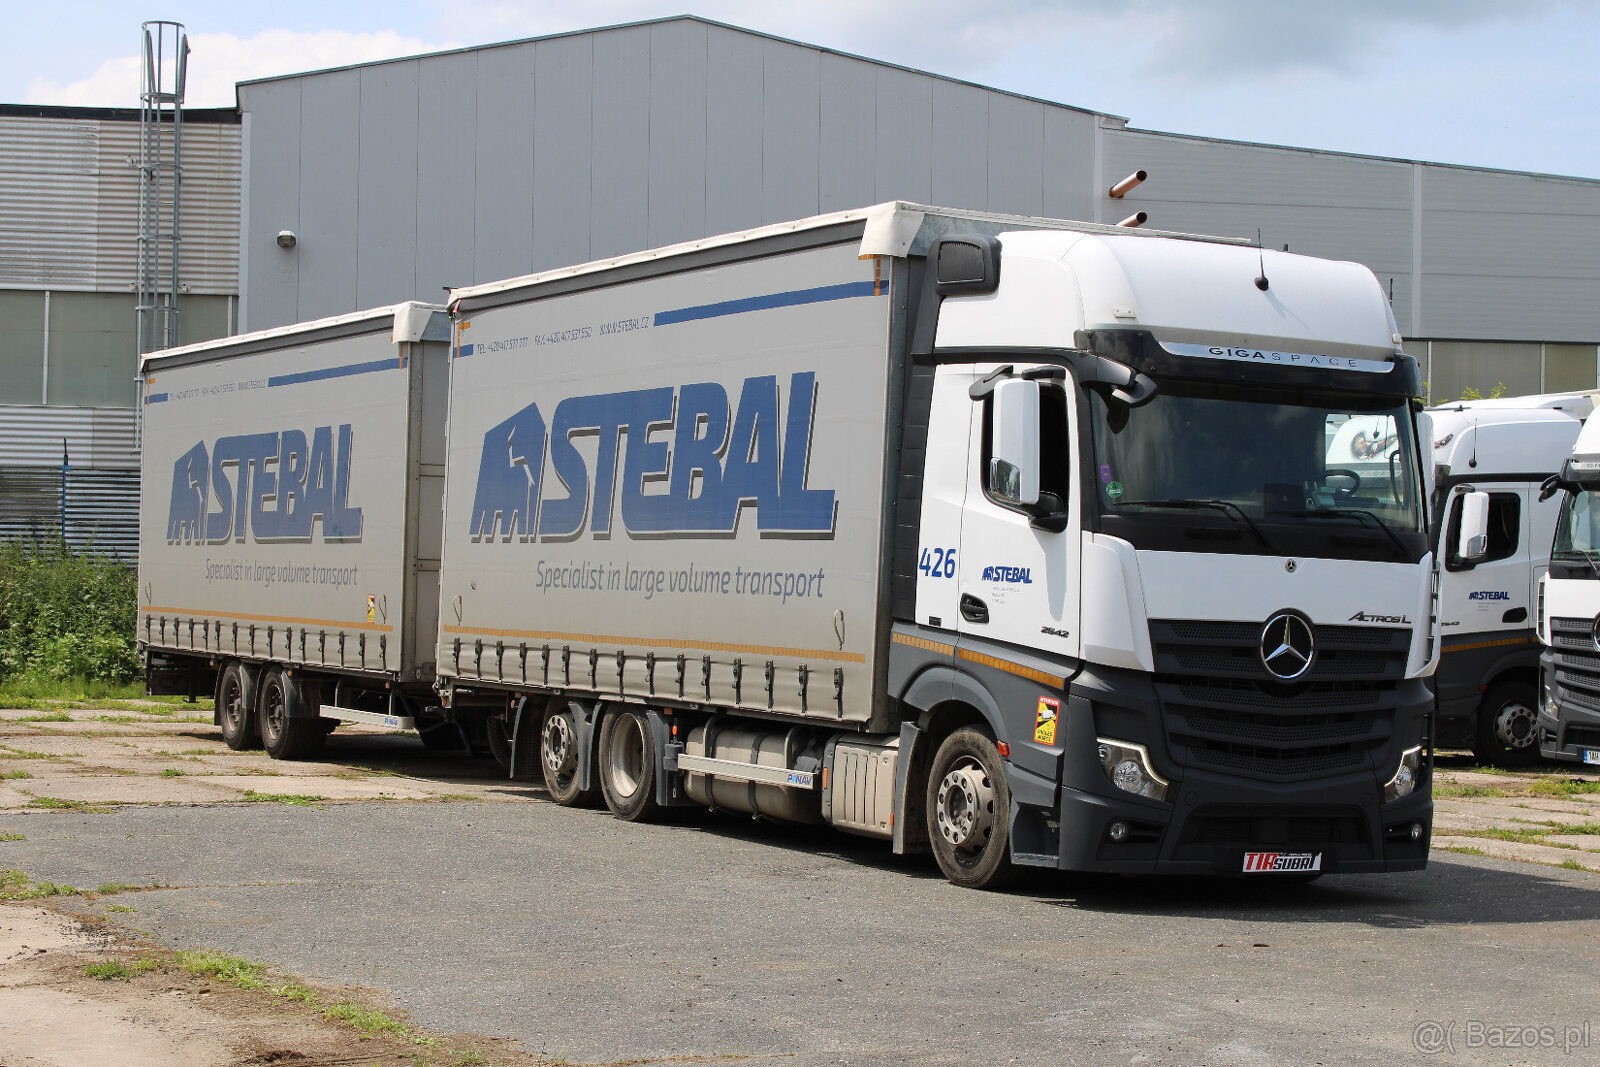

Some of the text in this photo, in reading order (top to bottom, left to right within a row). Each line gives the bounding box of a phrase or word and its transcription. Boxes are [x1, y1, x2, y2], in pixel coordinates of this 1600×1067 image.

[538, 371, 839, 542] STEBAL
[205, 424, 364, 545] STEBAL
[205, 558, 358, 591] Specialist in large volume transport
[919, 547, 957, 578] 426
[993, 566, 1032, 584] STEBAL
[535, 560, 825, 604] Specialist in large volume transport
[1479, 591, 1510, 600] STEBAL
[1040, 626, 1070, 638] 2542
[787, 773, 813, 785] PANAV
